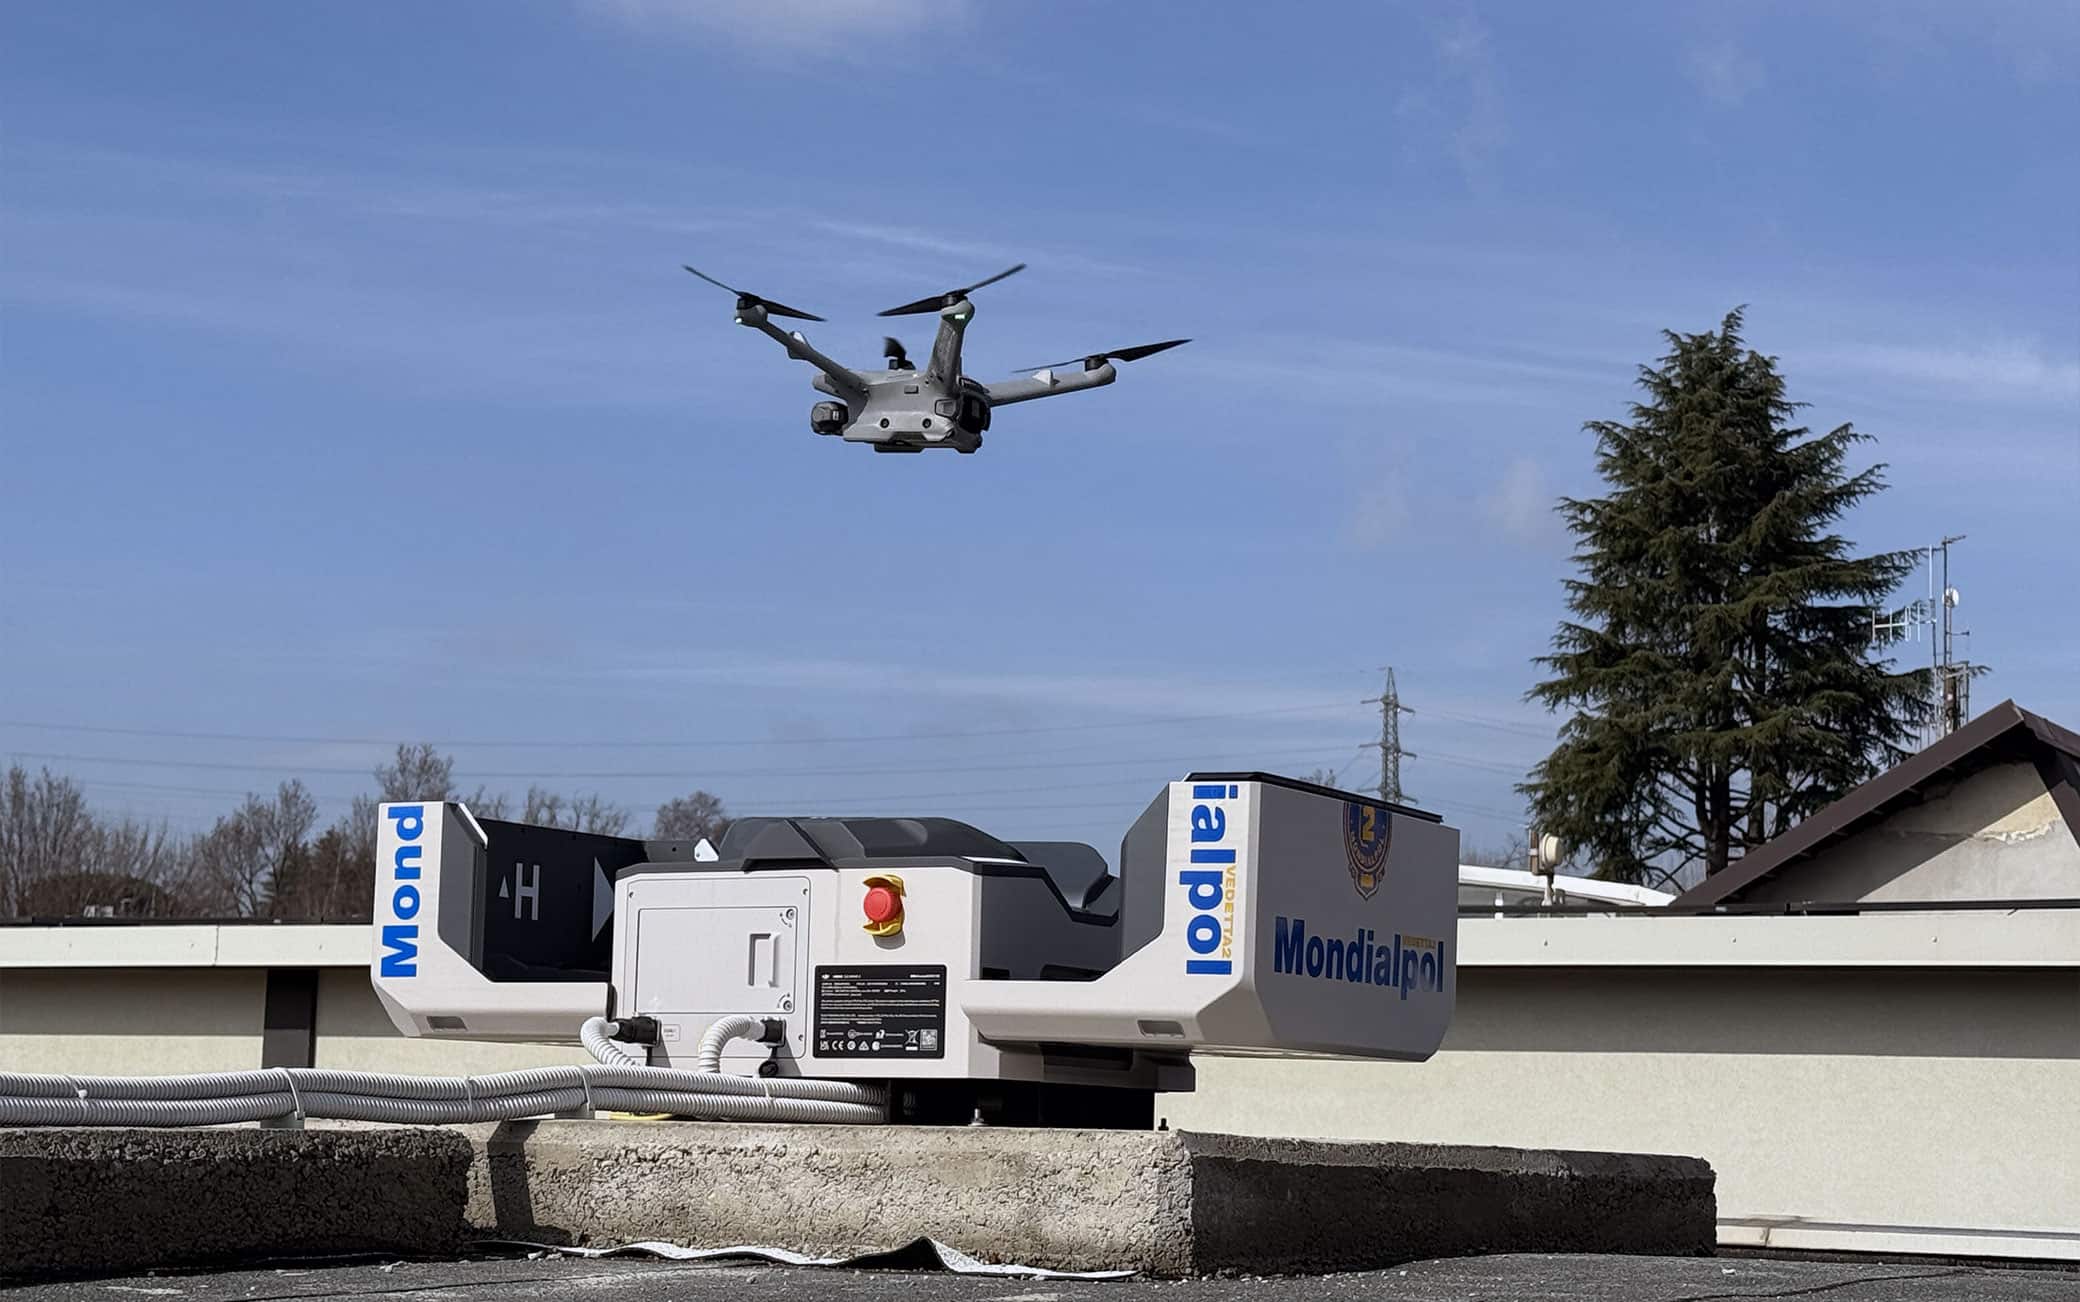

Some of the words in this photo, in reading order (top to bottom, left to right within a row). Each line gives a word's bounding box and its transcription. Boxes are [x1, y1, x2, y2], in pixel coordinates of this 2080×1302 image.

[380, 805, 425, 978] Mond
[513, 862, 541, 921] H
[1179, 784, 1239, 976] ialpol
[1222, 864, 1237, 959] VEDETTA2
[1273, 915, 1445, 1001] Mondialpol
